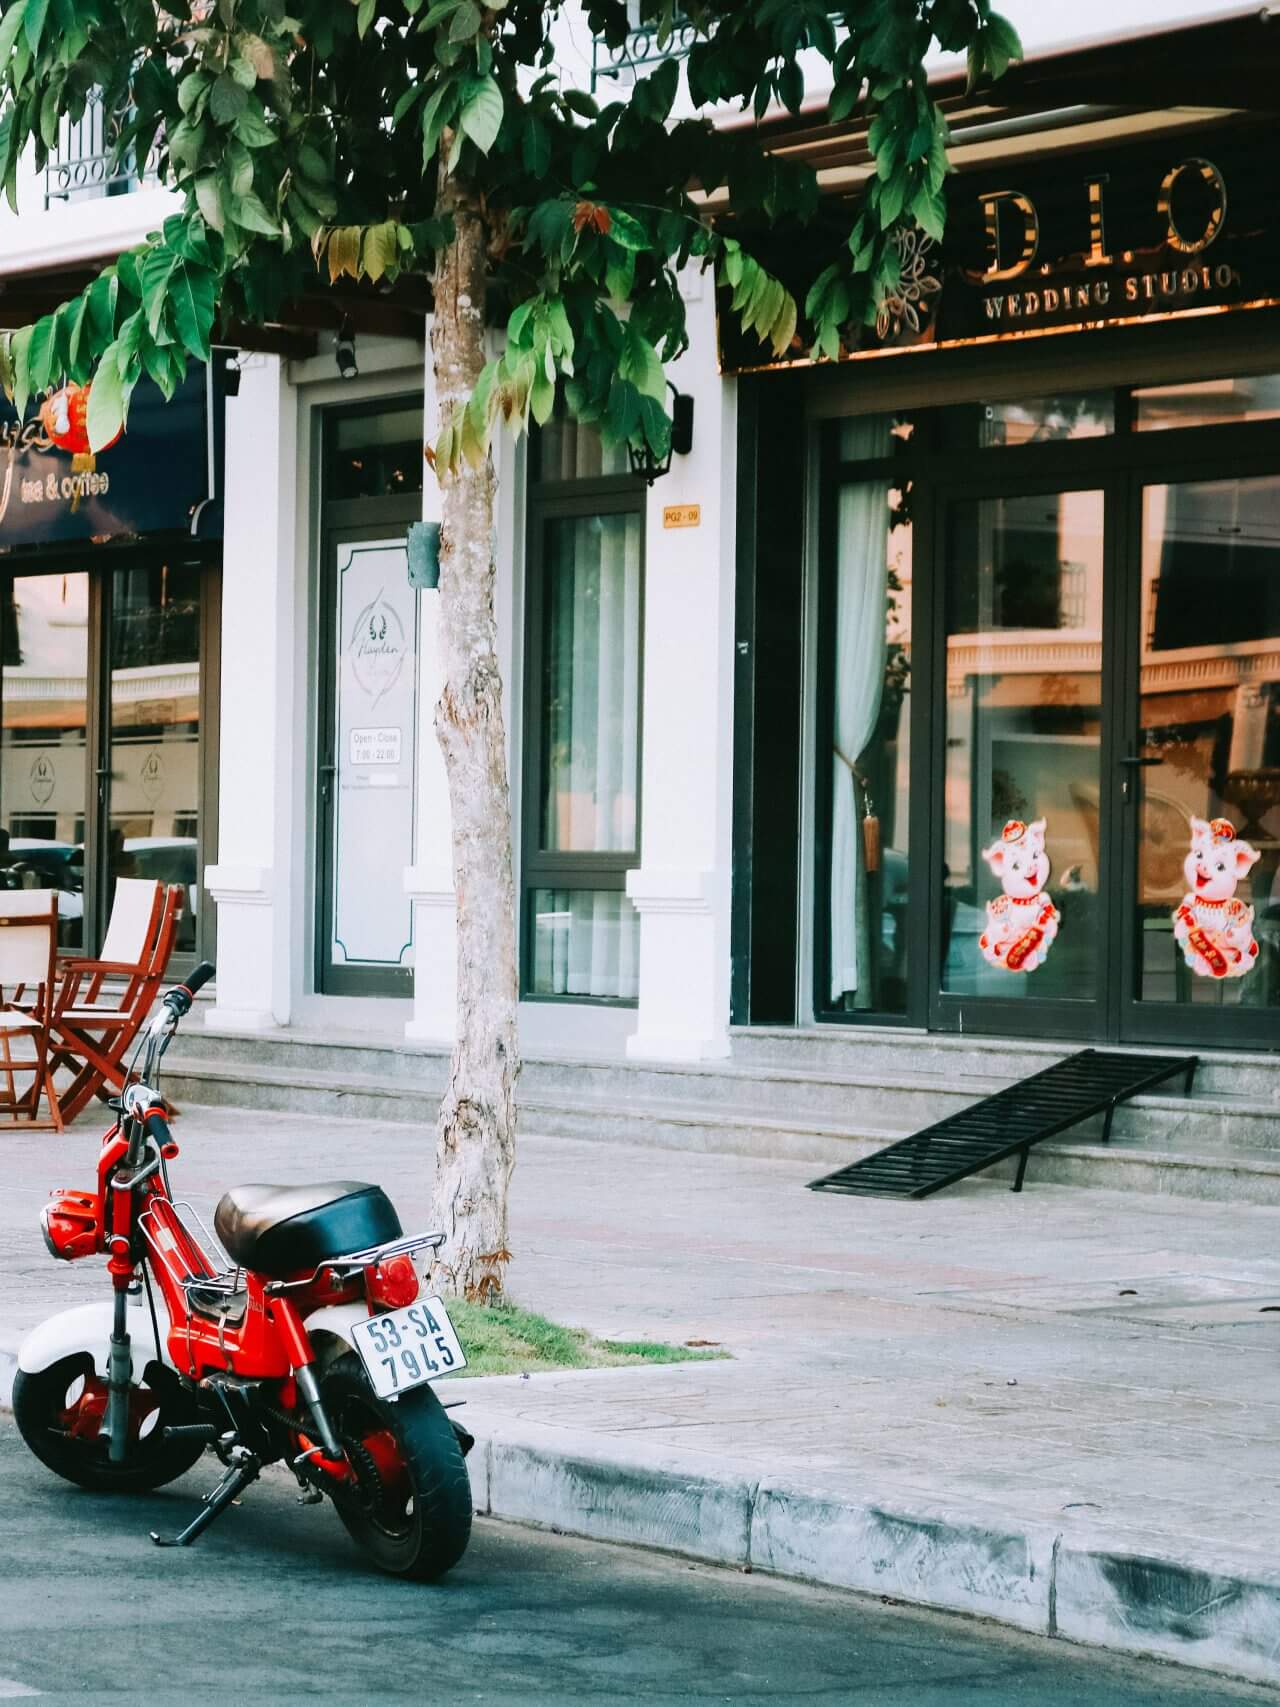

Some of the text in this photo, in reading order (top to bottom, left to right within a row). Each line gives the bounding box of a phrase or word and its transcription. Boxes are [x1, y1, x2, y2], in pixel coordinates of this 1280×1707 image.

[982, 263, 1234, 321] WEDDING STUDIO
[45, 472, 61, 500] &
[366, 1304, 441, 1353] 53-SA
[381, 1336, 455, 1388] 7945
